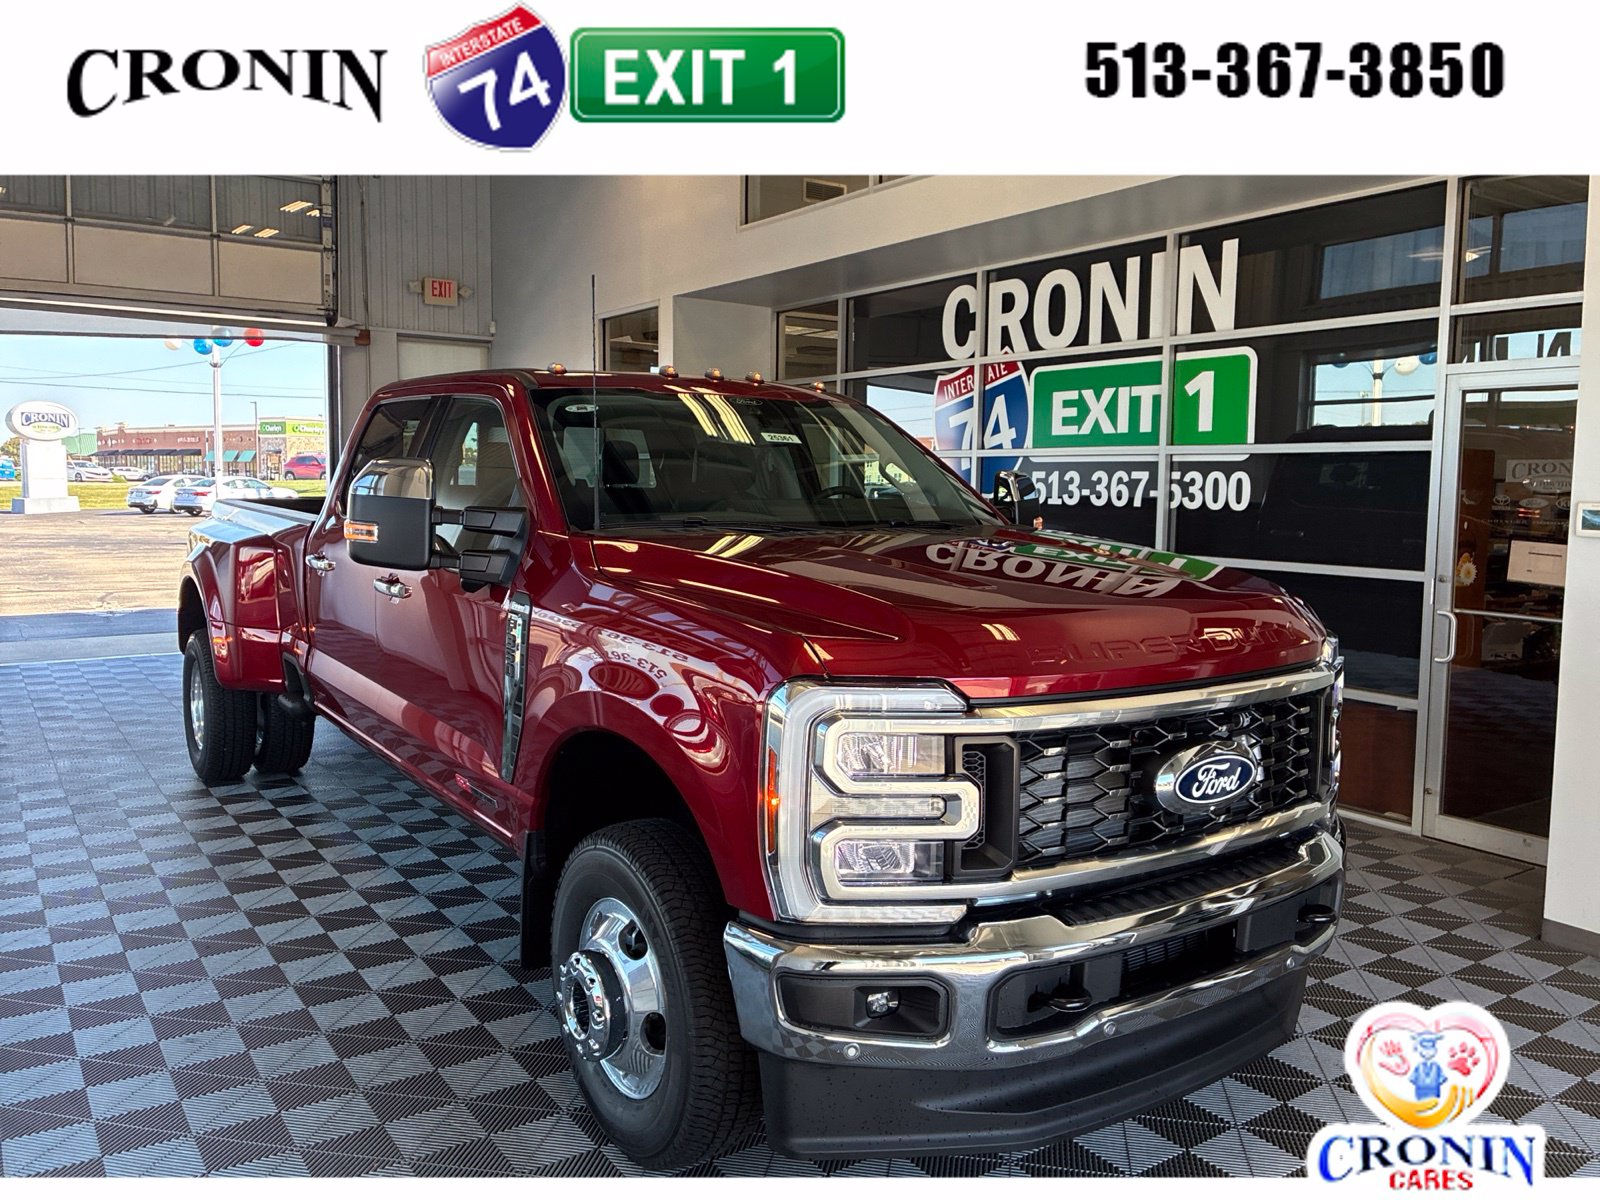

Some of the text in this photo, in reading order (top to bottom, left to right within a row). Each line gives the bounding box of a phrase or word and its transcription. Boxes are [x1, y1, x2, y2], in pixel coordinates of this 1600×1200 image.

[431, 279, 453, 298] EXIT
[942, 238, 1239, 361] CRONIN
[21, 412, 69, 428] CRONIN
[1051, 370, 1215, 436] EXIT 1
[949, 394, 1017, 471] 74
[1031, 470, 1252, 512] 513-367-5300
[1191, 762, 1242, 798] Ford
